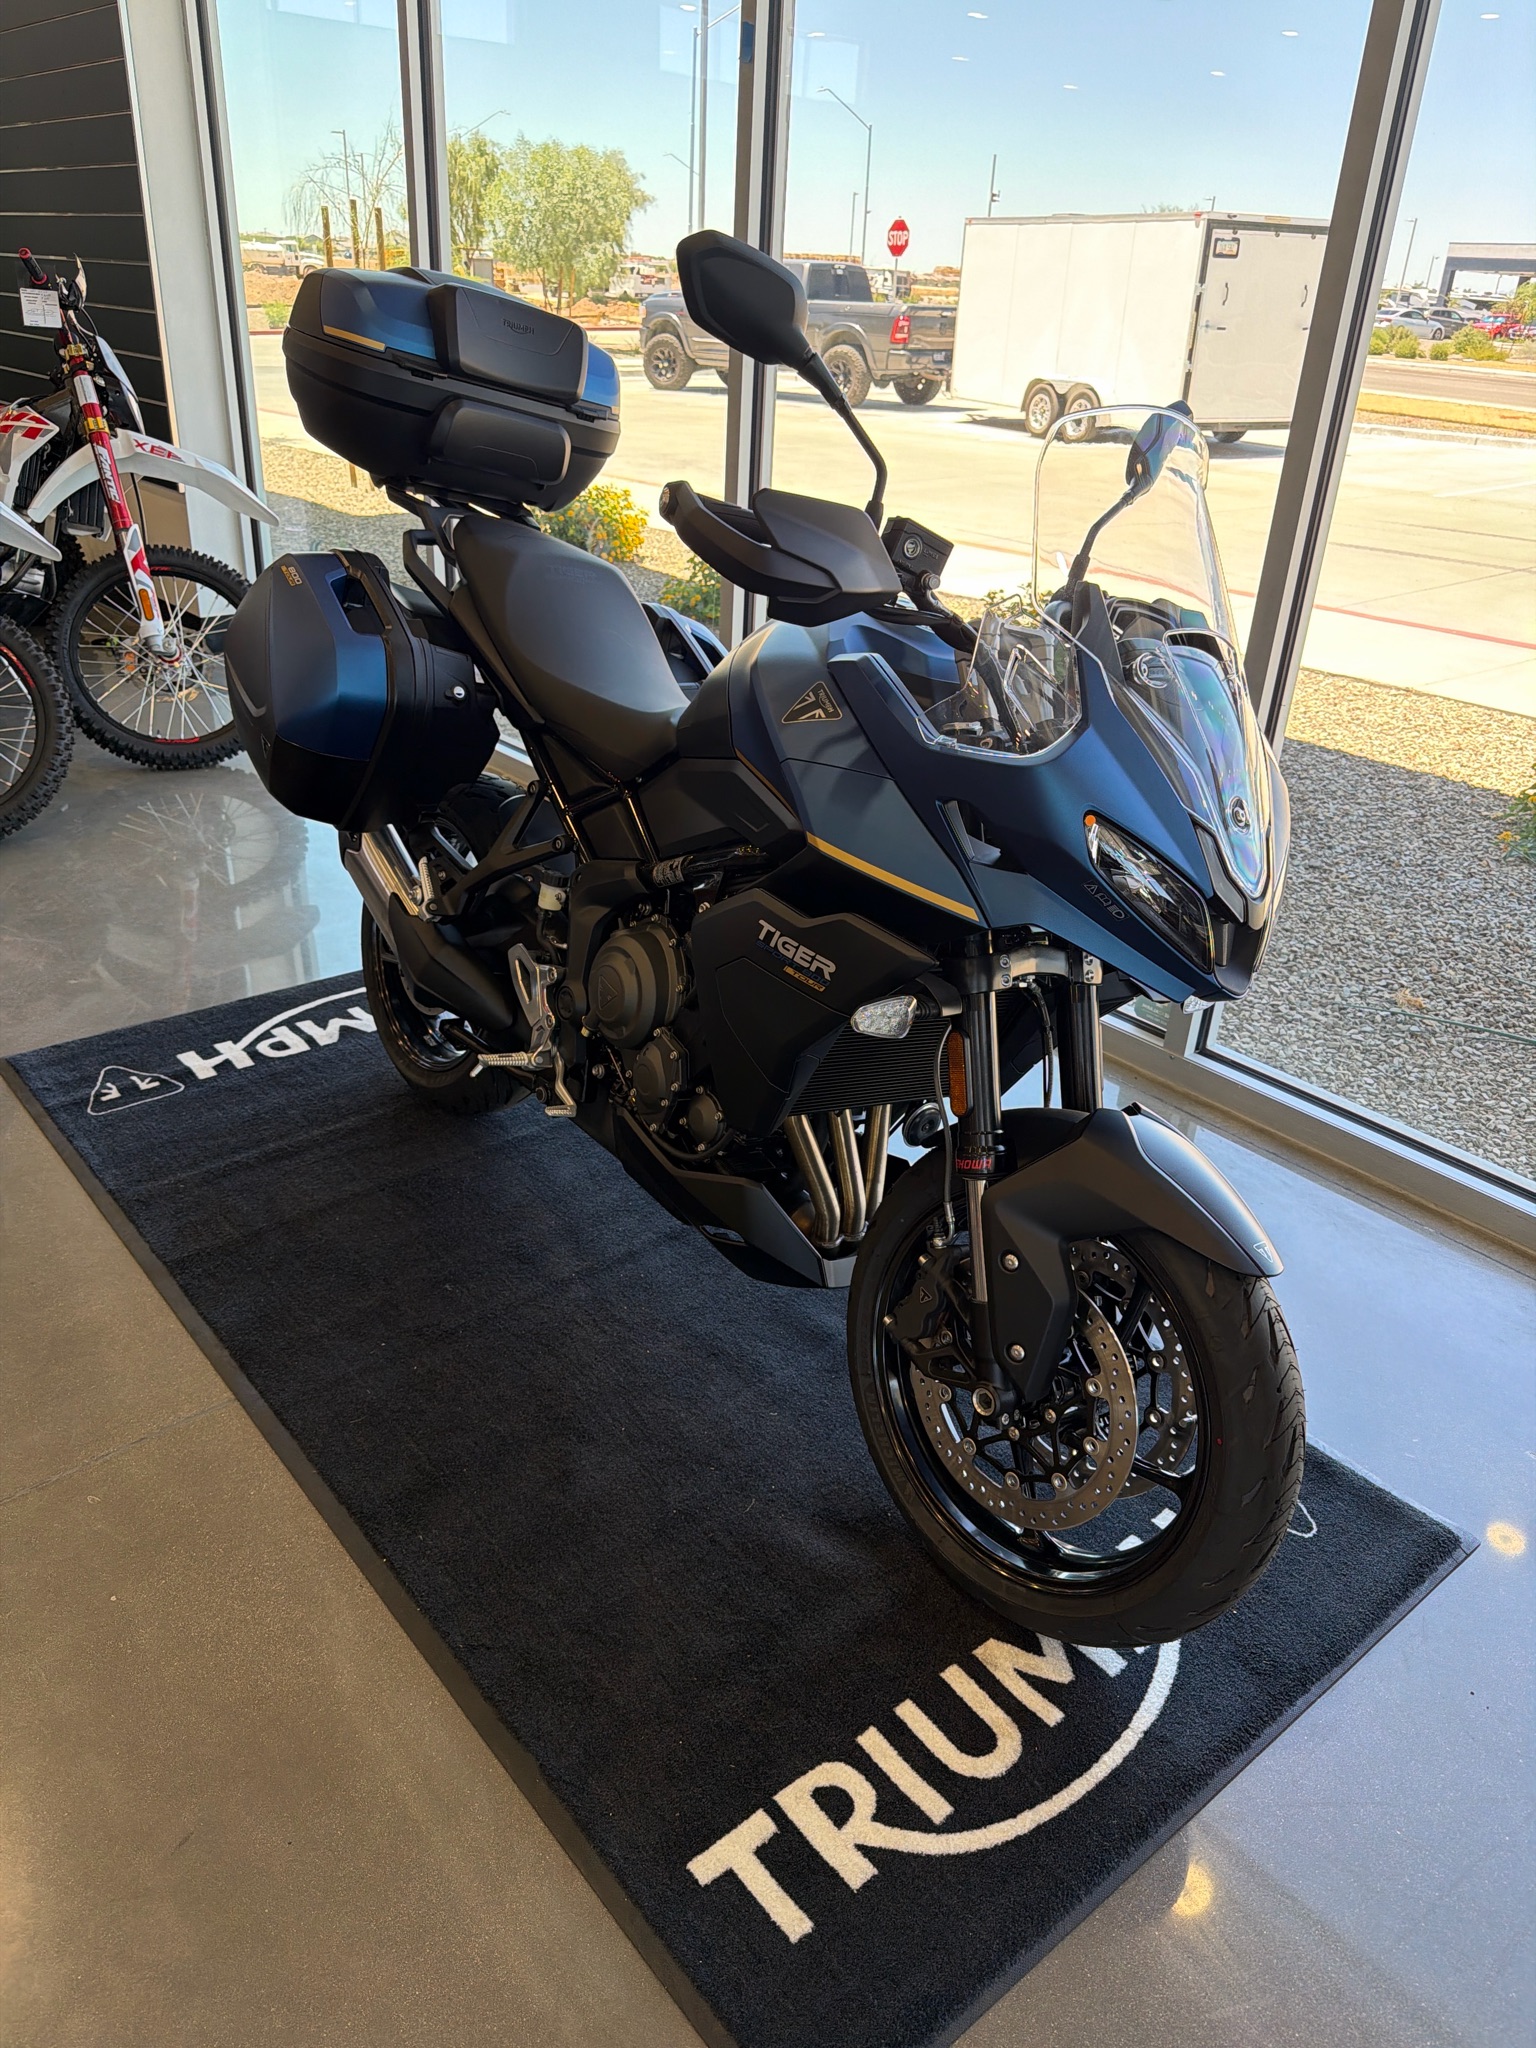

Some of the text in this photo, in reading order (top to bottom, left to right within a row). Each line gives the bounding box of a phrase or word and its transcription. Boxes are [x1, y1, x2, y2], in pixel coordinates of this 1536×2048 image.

[888, 230, 908, 246] STOP
[503, 318, 535, 335] TRIUMPH
[95, 443, 121, 503] FANTIC
[287, 566, 302, 584] 800
[818, 689, 834, 713] TRIUMPH
[755, 940, 831, 987] SPORT 800
[758, 919, 836, 981] TIGER
[792, 971, 823, 991] TOUR
[865, 1391, 905, 1482] MICHELIN
[687, 1631, 1180, 1944] TRIUM
